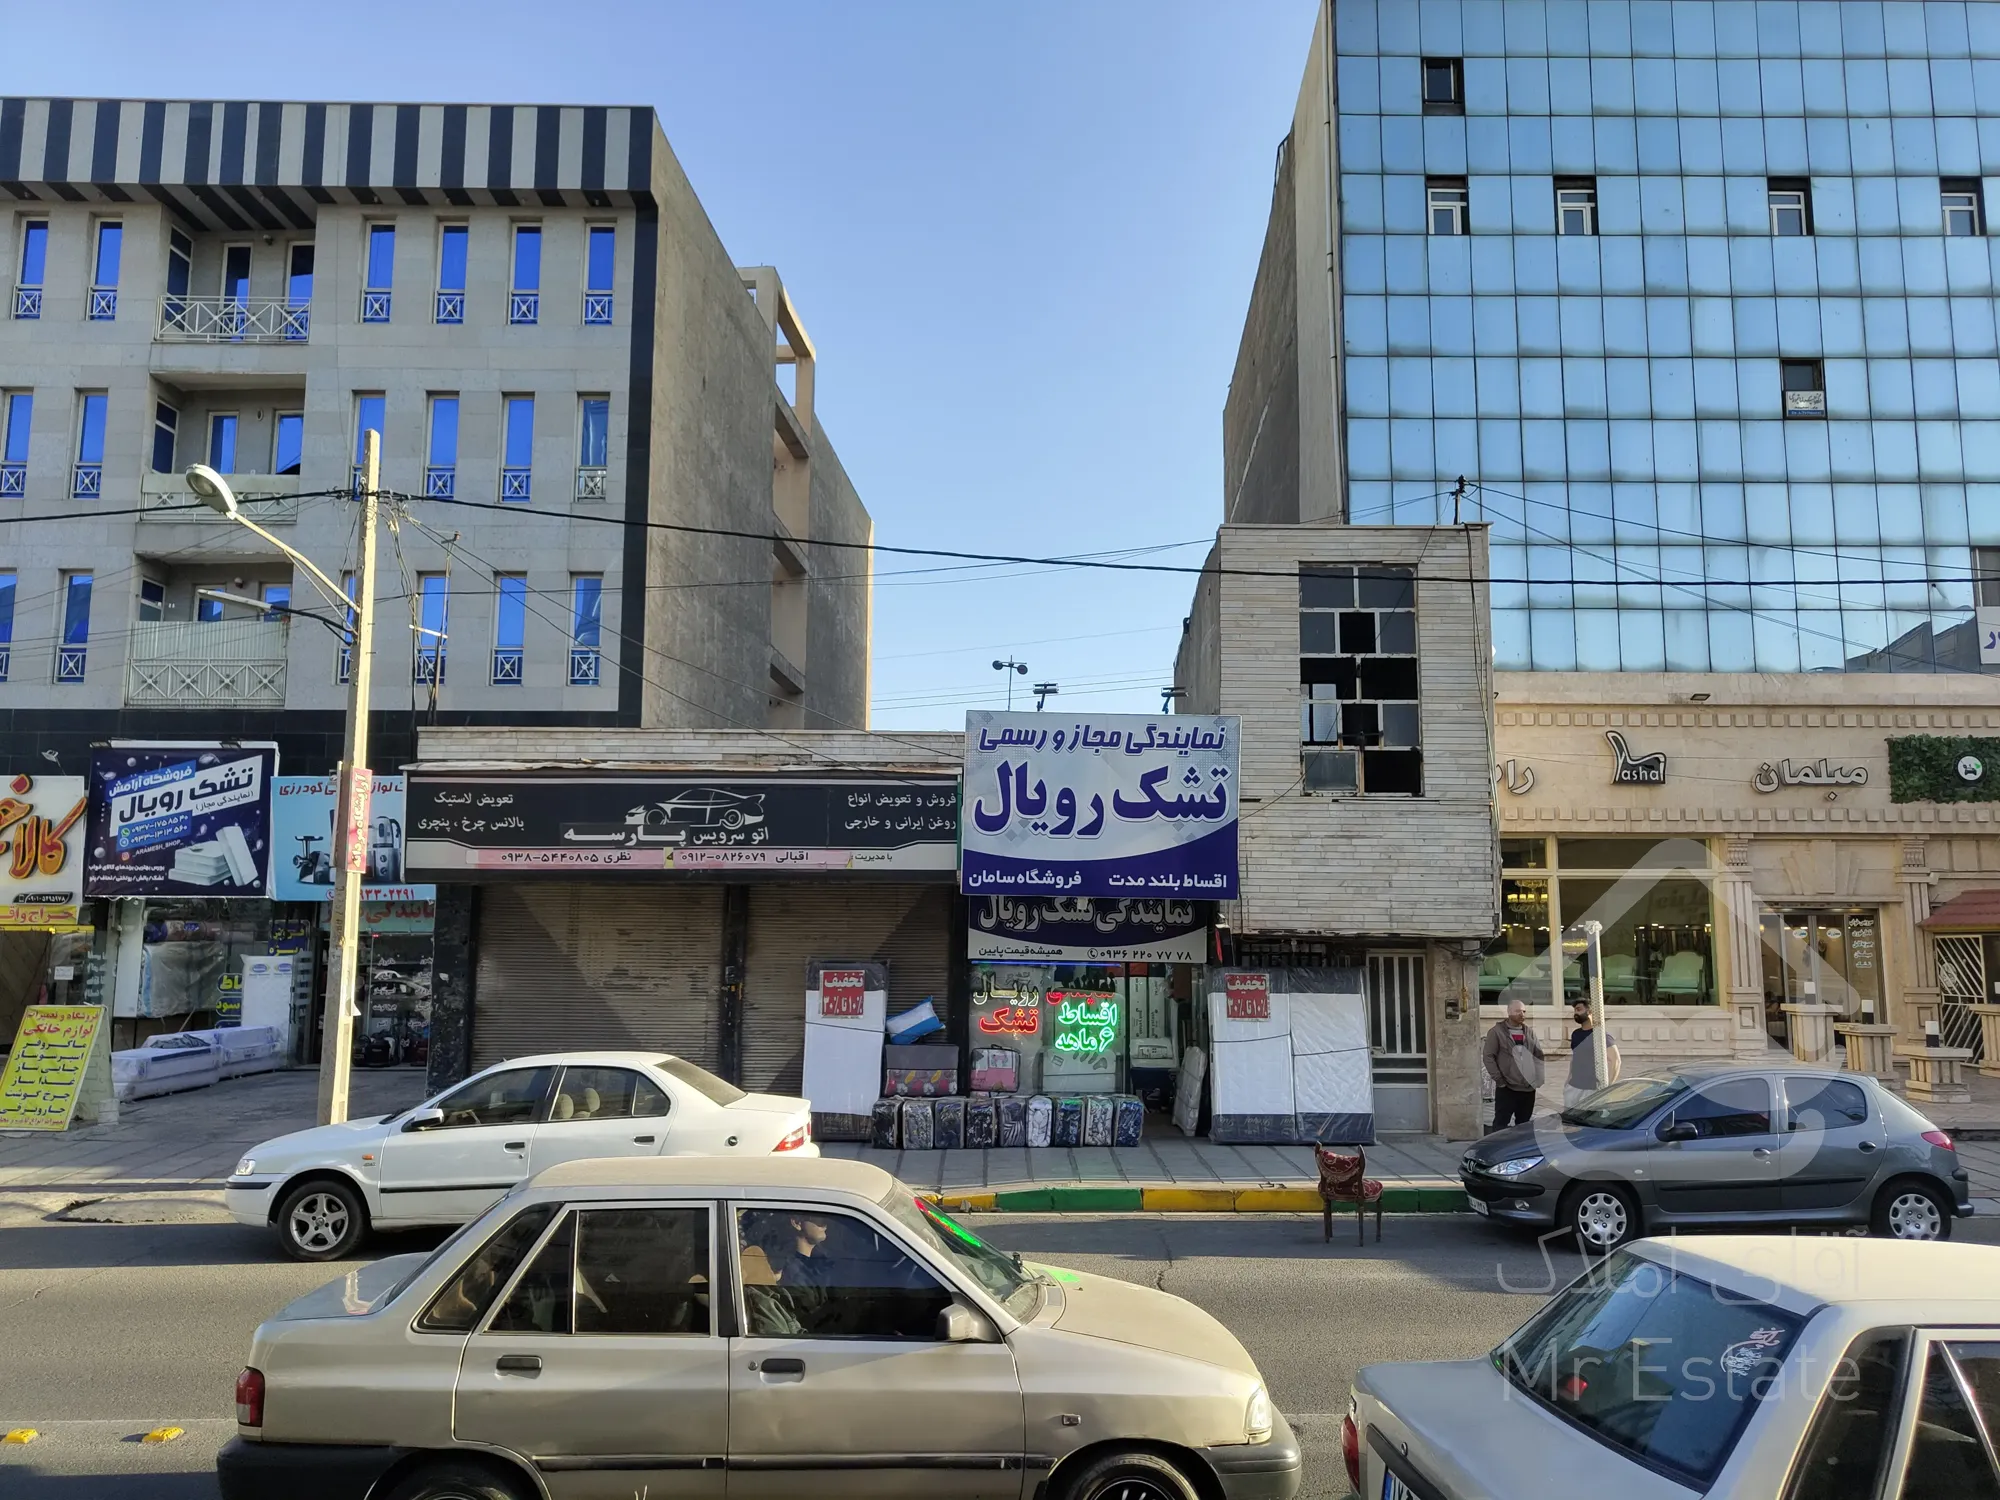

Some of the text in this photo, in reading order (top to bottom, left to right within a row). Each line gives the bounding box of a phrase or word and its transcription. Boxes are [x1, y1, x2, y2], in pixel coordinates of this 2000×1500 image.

[979, 724, 1225, 755] نمایندگی مجاز و رسمی
[109, 766, 193, 797] فروشگاه آرامش
[371, 782, 392, 793] لواز
[1755, 758, 1869, 801] مبلمان
[119, 766, 254, 823] تشک رویال
[279, 782, 322, 796] گودرزی
[434, 791, 514, 806] تعویض لاستیک
[847, 793, 957, 807] فروش و تعویض انواع
[974, 760, 1232, 835] تشک رویال
[418, 816, 450, 832] پنچری
[461, 817, 486, 831] چرخ
[490, 817, 524, 831] بالانس
[845, 816, 956, 830] روغن ایرانی و خارجی
[0, 796, 88, 879] کالا
[563, 825, 769, 846] اتو سرویس پارسه
[501, 852, 631, 864] نظری ۰۹۳۸-۵۴۴۰۸۰۵
[681, 852, 766, 862] ۰۹۱۲-۰۸۲۶۰۷۹
[776, 851, 808, 863] اقبالی
[883, 853, 892, 862] با
[968, 870, 1227, 891] اقساط بلند مدت فروشگاه سامان
[0, 905, 74, 923] حراج واق
[980, 895, 1193, 932] نمایندگی تشک رویال
[979, 946, 1192, 960] همیشه قیمت پایین ۰۹۳۶ ۲۲۰ ۷۷ ۷۸
[825, 972, 864, 991] تخفیف
[973, 972, 1039, 1006] رویال
[1227, 976, 1266, 994] تخفیف
[842, 997, 847, 1012] تا
[1246, 999, 1252, 1014] تا
[26, 1010, 99, 1023] فروشگاه و تعمیرات
[979, 1008, 1039, 1034] تشک
[1057, 1001, 1118, 1026] اقساط
[23, 1022, 94, 1038] لوازم خانگی
[5, 1090, 70, 1101] چرخ گوشت
